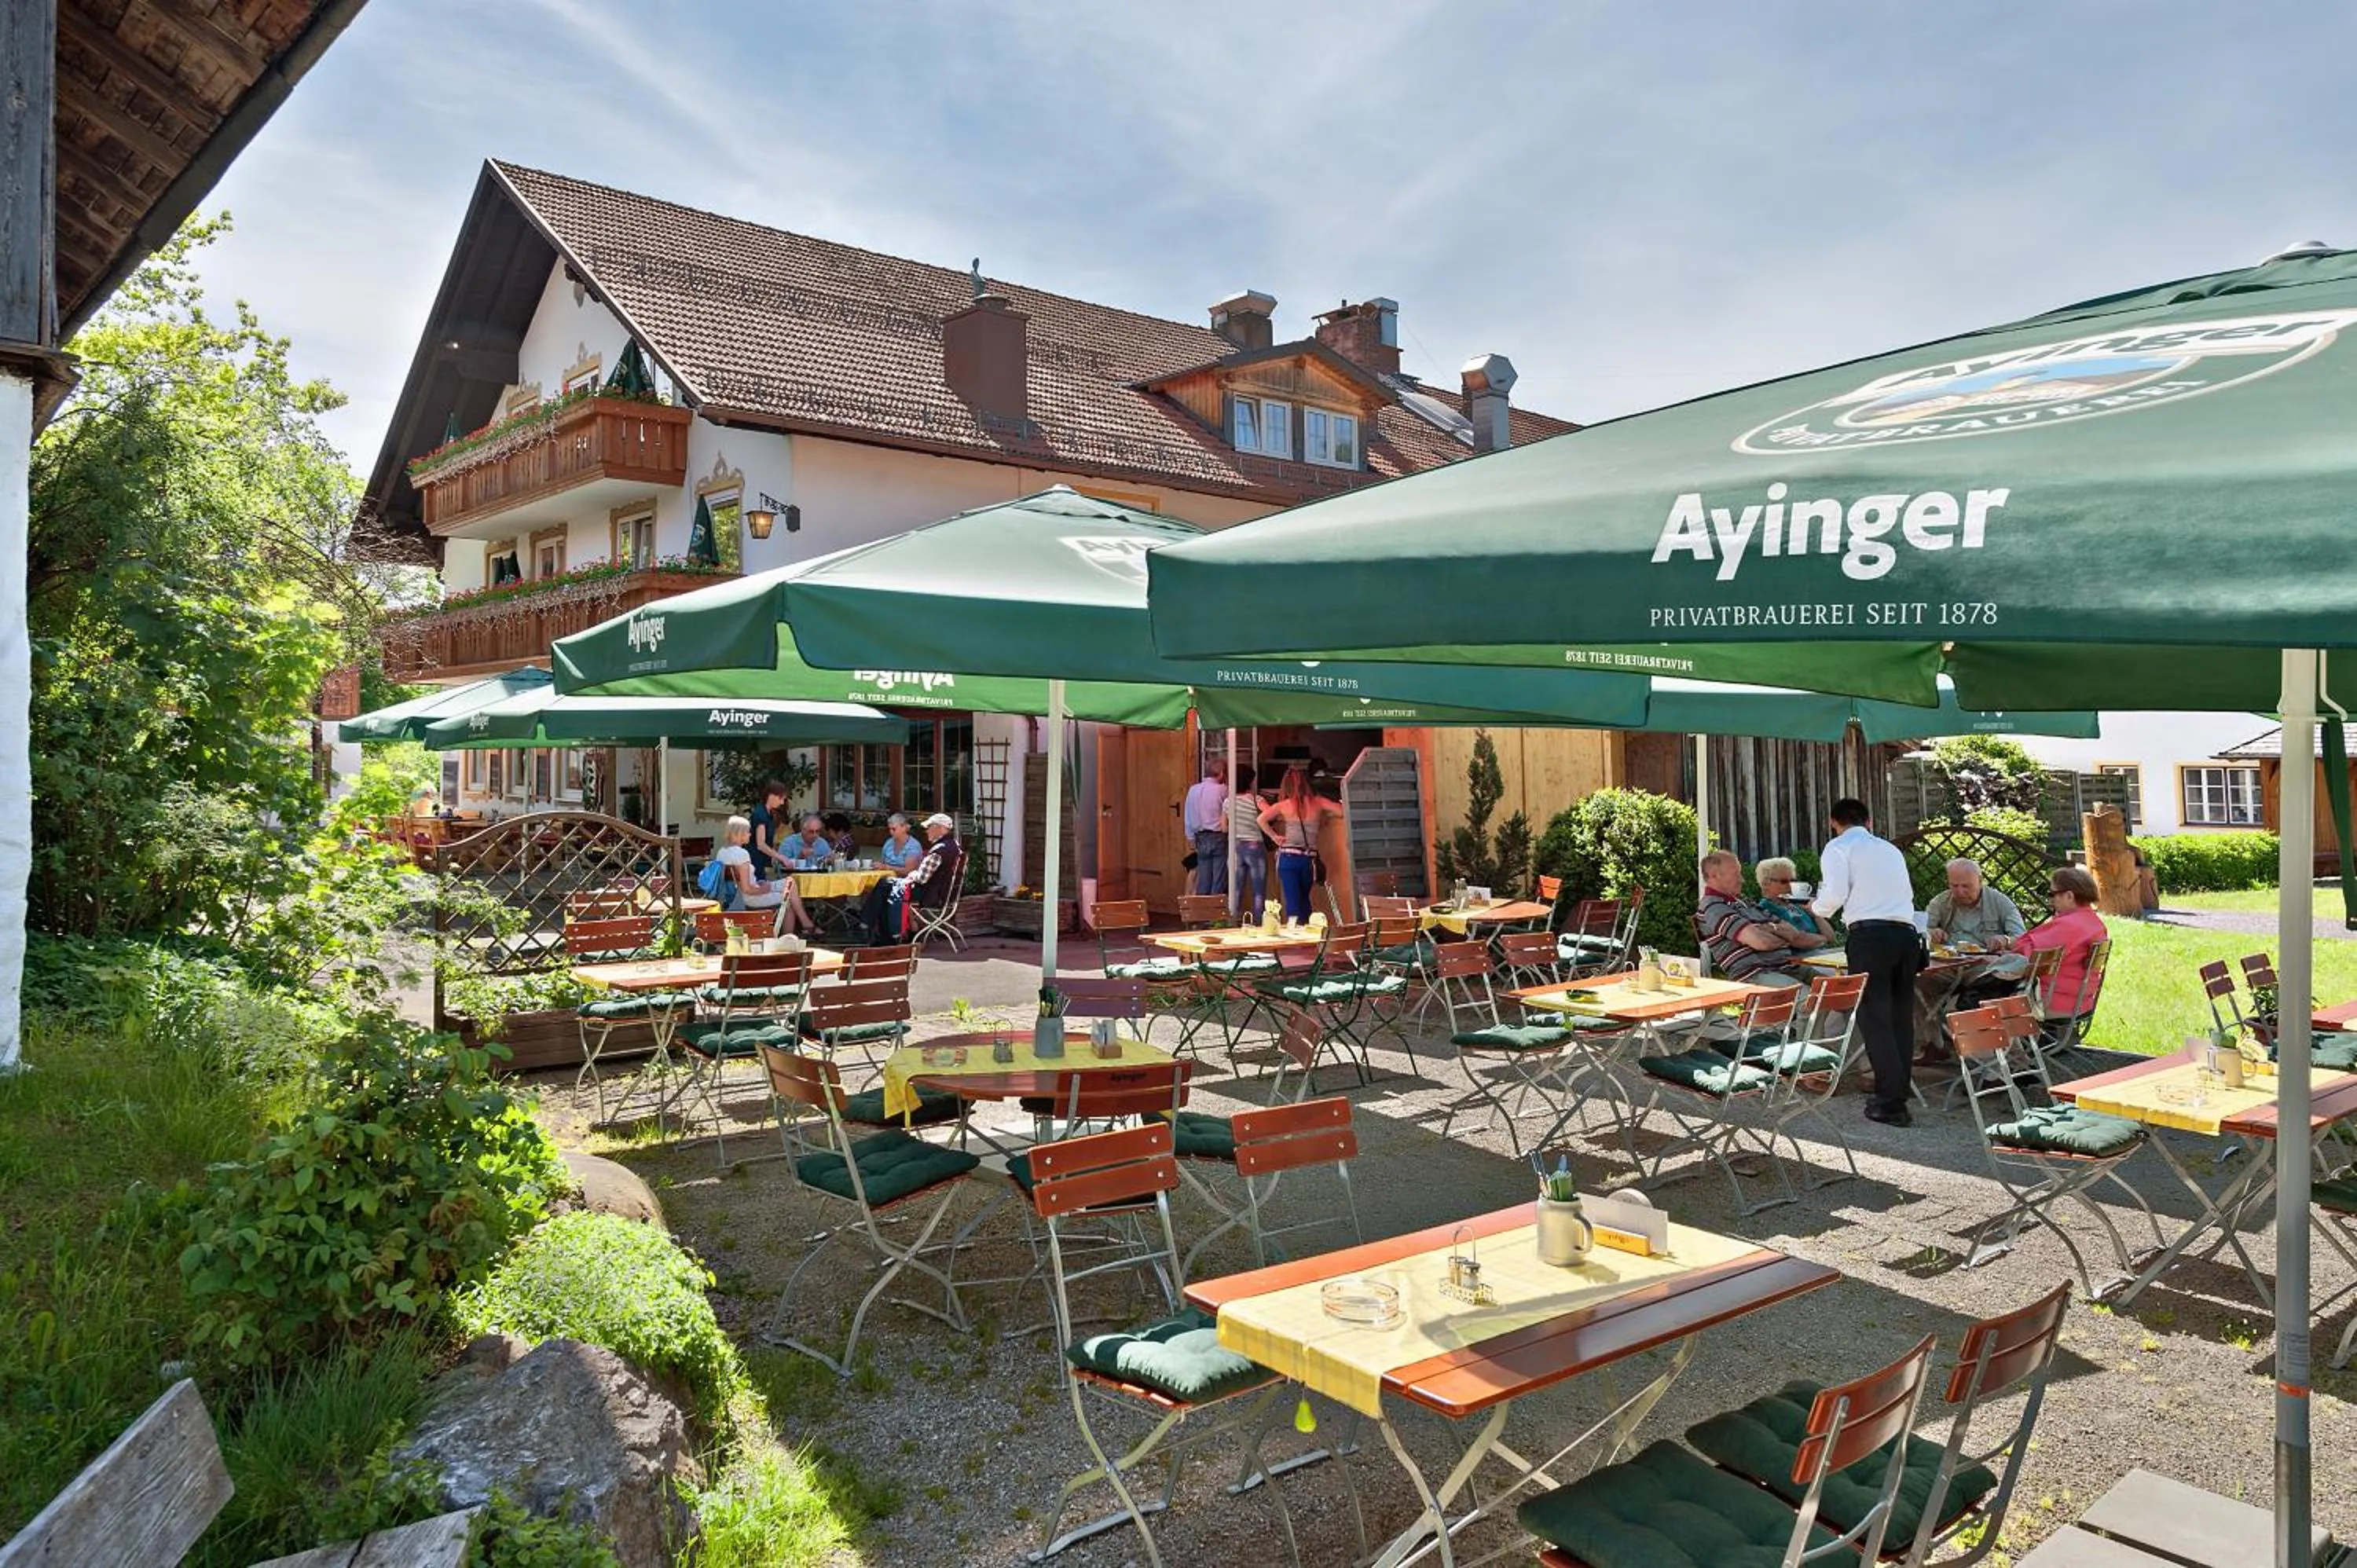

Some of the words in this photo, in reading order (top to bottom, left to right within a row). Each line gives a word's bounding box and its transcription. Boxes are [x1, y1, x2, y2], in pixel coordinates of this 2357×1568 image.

[1879, 317, 2341, 389] Ayinger
[1651, 482, 2011, 581] Ayinger
[1650, 603, 1855, 627] PRIVATBRAUEREI
[1866, 603, 1927, 625] SEIT
[1938, 603, 1998, 625] 1878
[1216, 670, 1308, 686] PRIVATBRAUEREI
[1311, 676, 1334, 688] SEIT
[1337, 678, 1359, 689] 1878
[708, 709, 770, 727] Ayinger
